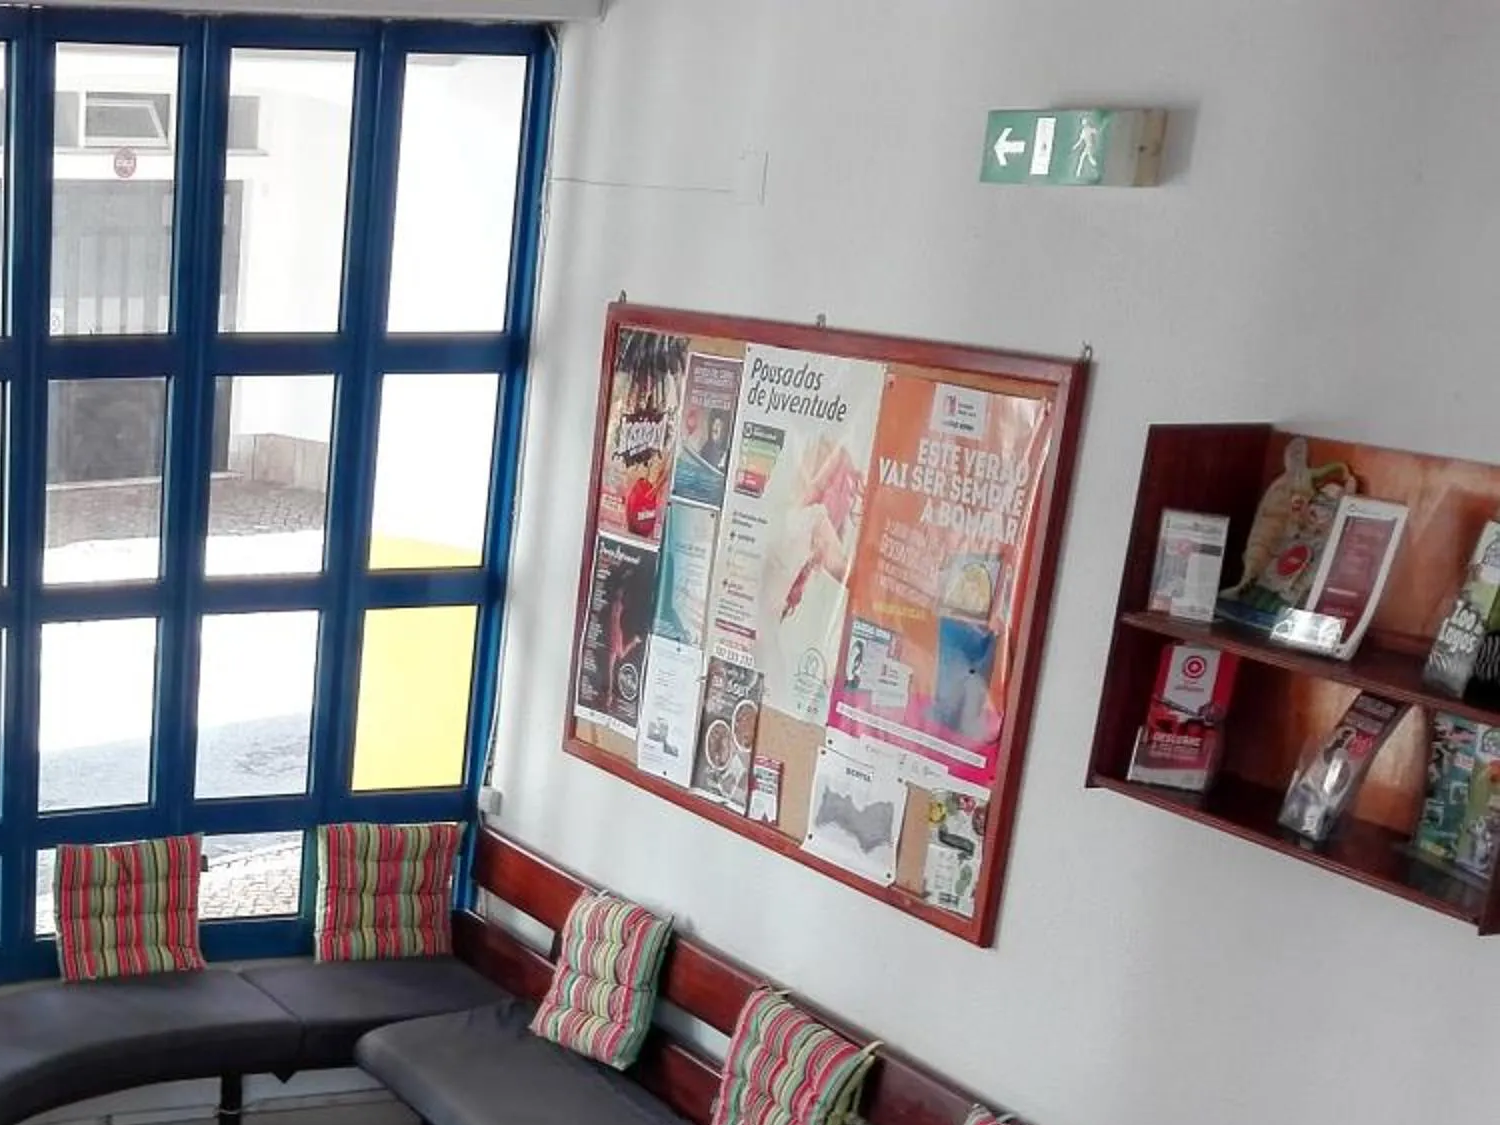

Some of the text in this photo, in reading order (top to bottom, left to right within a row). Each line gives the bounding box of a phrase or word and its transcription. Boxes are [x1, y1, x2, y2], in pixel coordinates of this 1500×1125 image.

[751, 357, 824, 391] Pousadas
[748, 381, 766, 406] de
[917, 438, 961, 474] ESTE
[879, 456, 1026, 517] VAI SER SEMPRE
